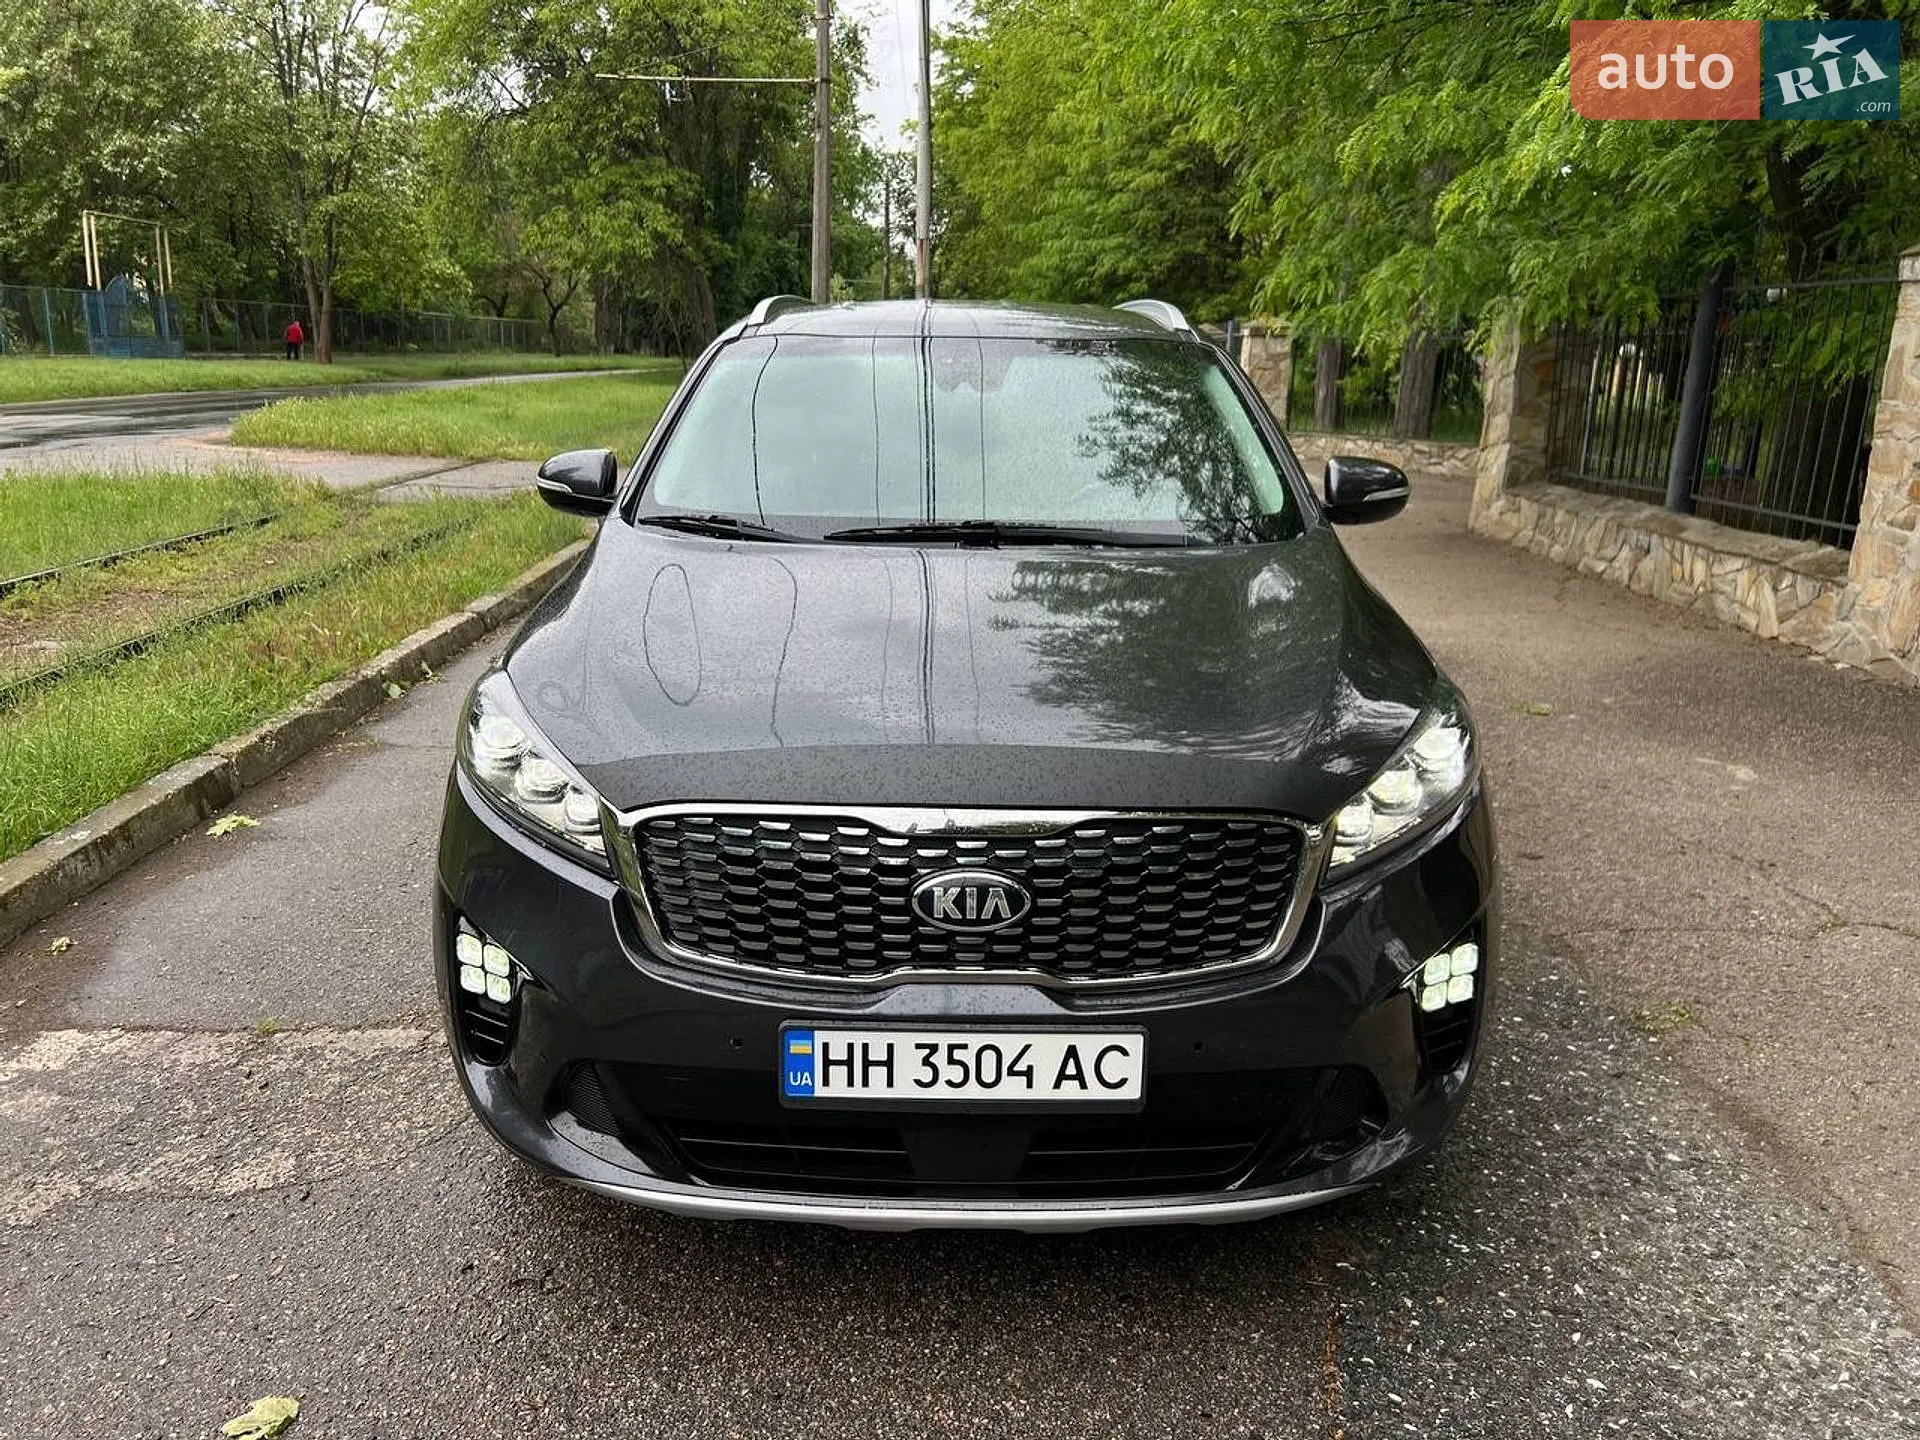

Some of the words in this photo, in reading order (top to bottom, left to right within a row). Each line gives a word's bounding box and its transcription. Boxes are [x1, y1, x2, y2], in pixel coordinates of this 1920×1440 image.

[932, 887, 1011, 919] KIA
[790, 1071, 812, 1086] UA
[821, 1042, 894, 1088] HH
[912, 1043, 1033, 1089] 3504
[1052, 1044, 1131, 1090] AC
